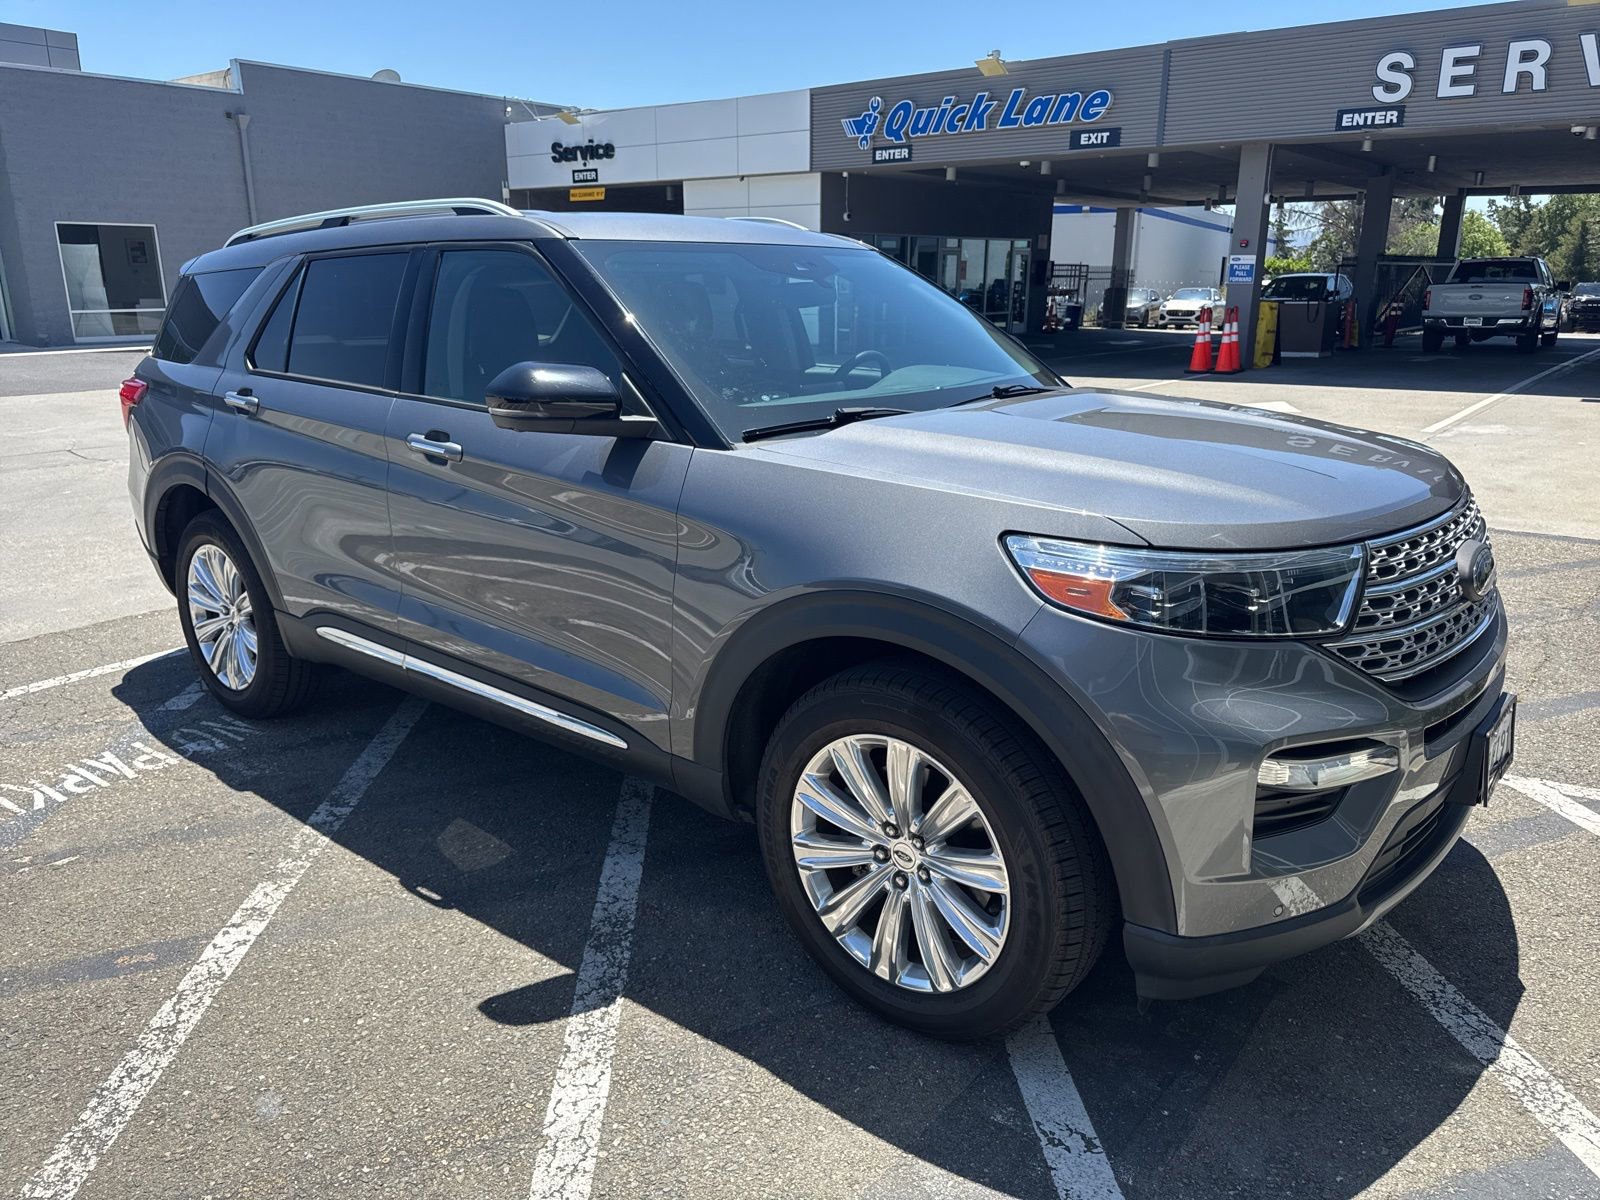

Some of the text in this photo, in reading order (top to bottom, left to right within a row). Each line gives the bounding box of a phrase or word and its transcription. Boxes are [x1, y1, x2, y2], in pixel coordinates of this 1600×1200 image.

[883, 87, 1113, 143] Quick Lane
[1341, 110, 1398, 127] ENTER
[1080, 132, 1110, 146] EXIT
[551, 139, 615, 163] Service
[875, 148, 909, 161] ENTER
[574, 171, 597, 181] ENTER
